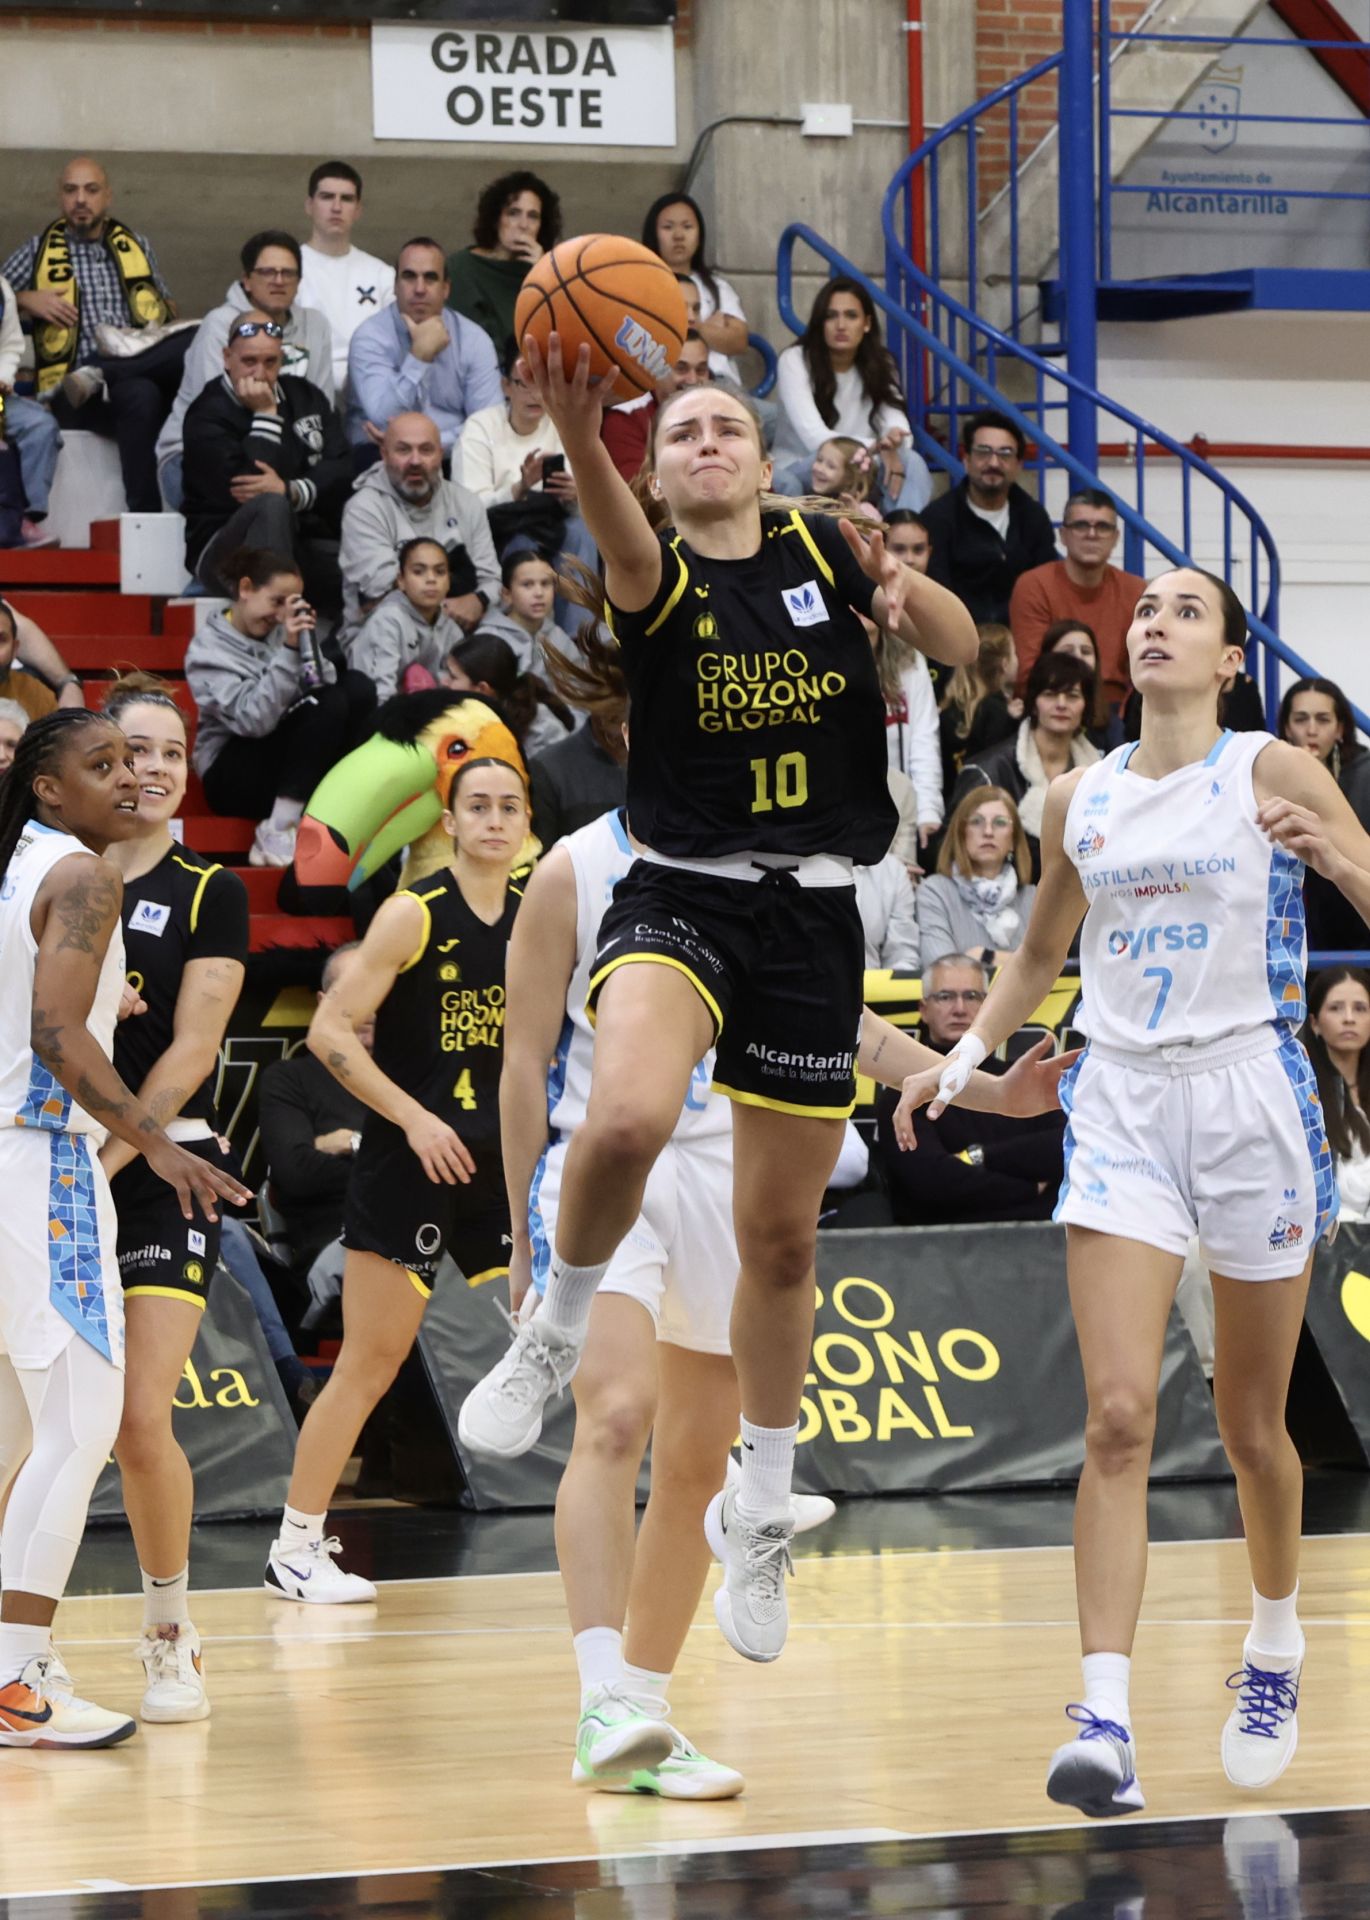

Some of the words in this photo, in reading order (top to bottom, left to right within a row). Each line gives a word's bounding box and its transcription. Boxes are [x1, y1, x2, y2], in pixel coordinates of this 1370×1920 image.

[431, 32, 616, 77] GRADA
[446, 85, 602, 128] OESTE
[1161, 170, 1253, 184] Ayuntamiento
[1256, 172, 1272, 184] de
[1147, 191, 1288, 214] Alcantarilla
[697, 649, 808, 683] GRUPO
[698, 671, 846, 710] HOZONO
[699, 702, 821, 733] GLOBAL
[750, 751, 808, 813] 10
[1163, 863, 1175, 881] Y
[1184, 853, 1235, 876] LEÓN
[441, 985, 505, 1012] GRUO
[1143, 967, 1173, 1030] 7
[441, 1004, 506, 1033] HOON
[441, 1026, 499, 1052] GLBAL
[789, 1066, 797, 1078] la
[830, 1070, 850, 1080] nace
[453, 1068, 478, 1110] 4
[118, 1244, 171, 1266] ntarilla
